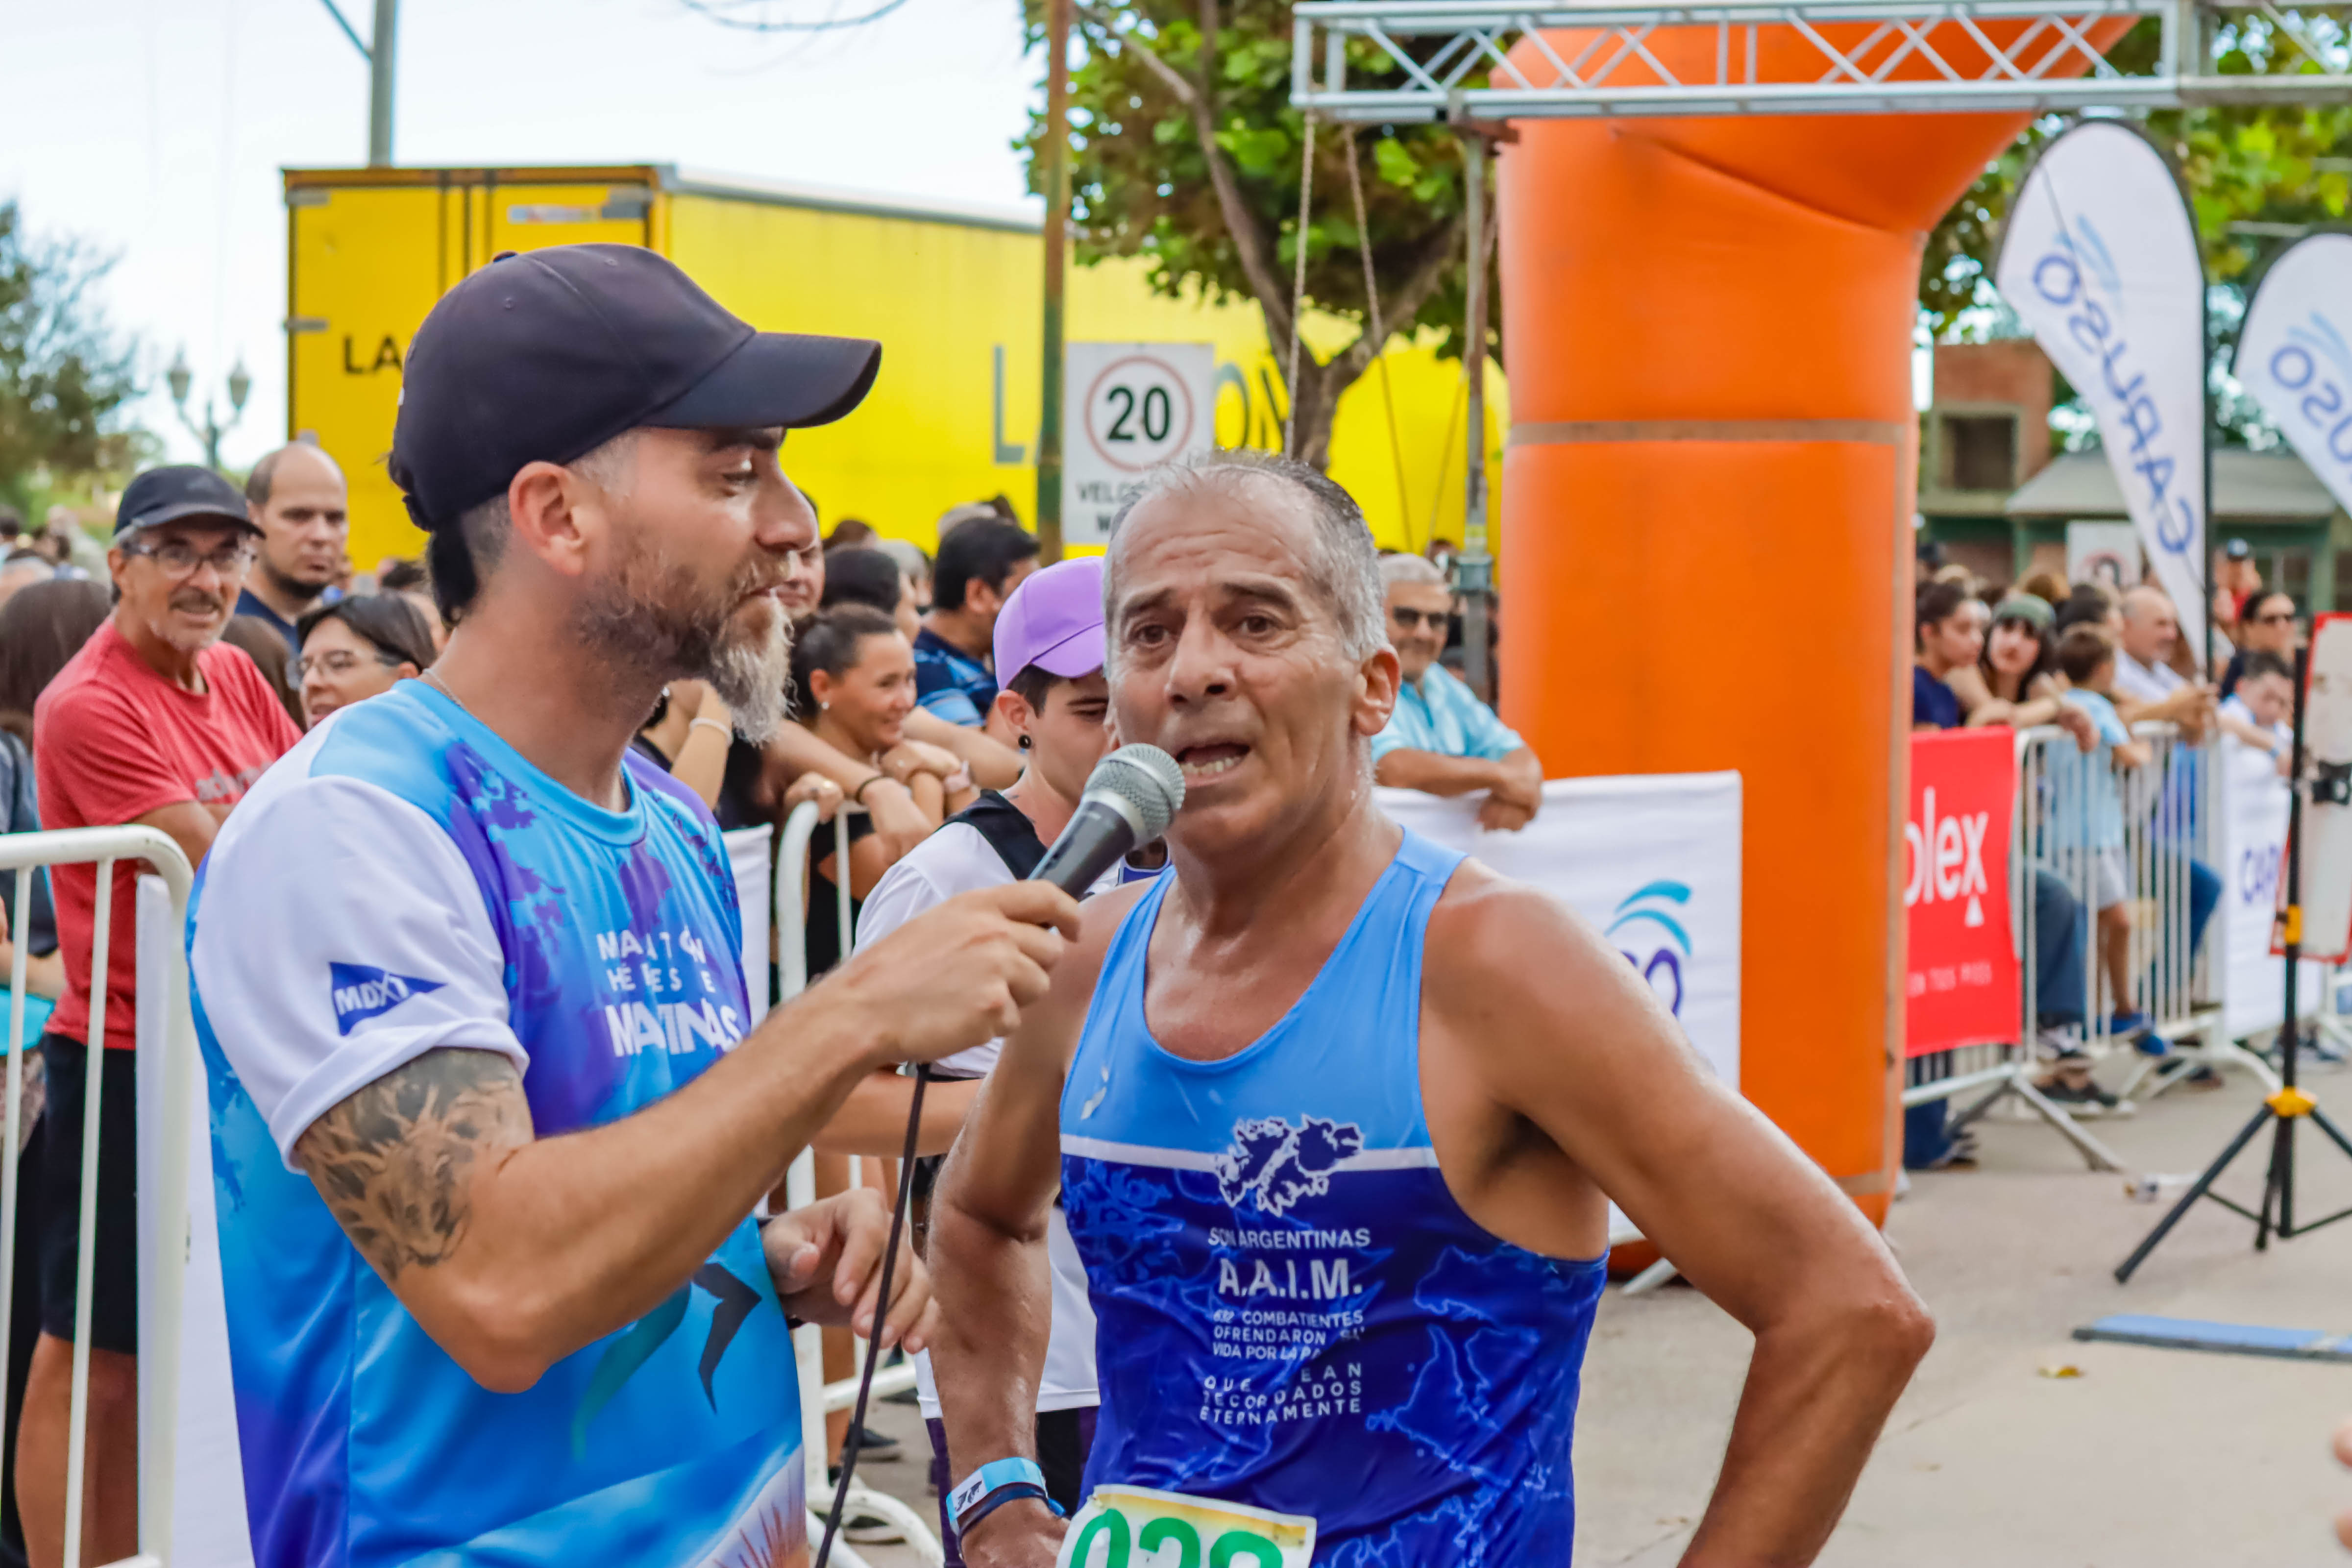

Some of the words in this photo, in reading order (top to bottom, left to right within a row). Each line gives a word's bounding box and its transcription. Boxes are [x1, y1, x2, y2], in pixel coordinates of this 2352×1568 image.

[1107, 385, 1172, 442] 20
[1239, 1227, 1372, 1249] ARGENTINAS
[1242, 1309, 1364, 1328] COMBATIENTES
[1214, 1324, 1326, 1345] OFRENDARON
[1213, 1342, 1242, 1359] VIDA
[1246, 1345, 1277, 1360] POR
[1280, 1346, 1298, 1360] LA
[1204, 1375, 1251, 1392] QUE
[1300, 1362, 1362, 1383] EAN
